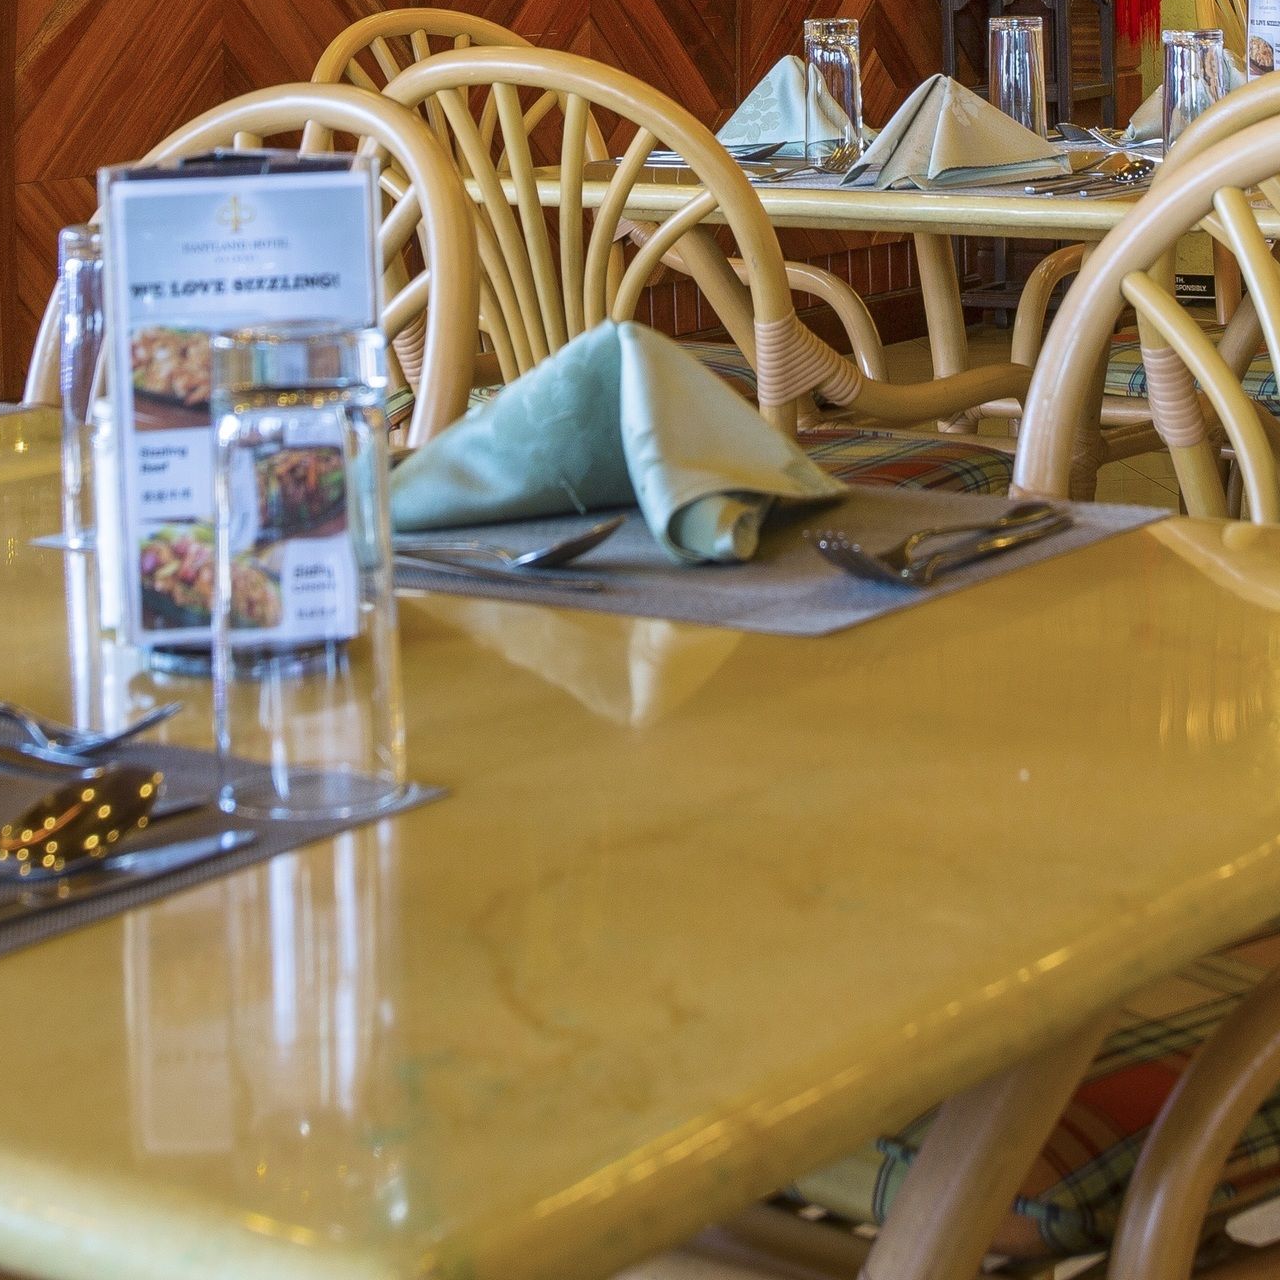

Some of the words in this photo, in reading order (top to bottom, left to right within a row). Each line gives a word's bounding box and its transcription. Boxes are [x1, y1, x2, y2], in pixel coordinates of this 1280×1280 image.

[131, 282, 162, 298] WE
[170, 279, 224, 298] LOVE
[233, 272, 340, 292] SIZZLING!
